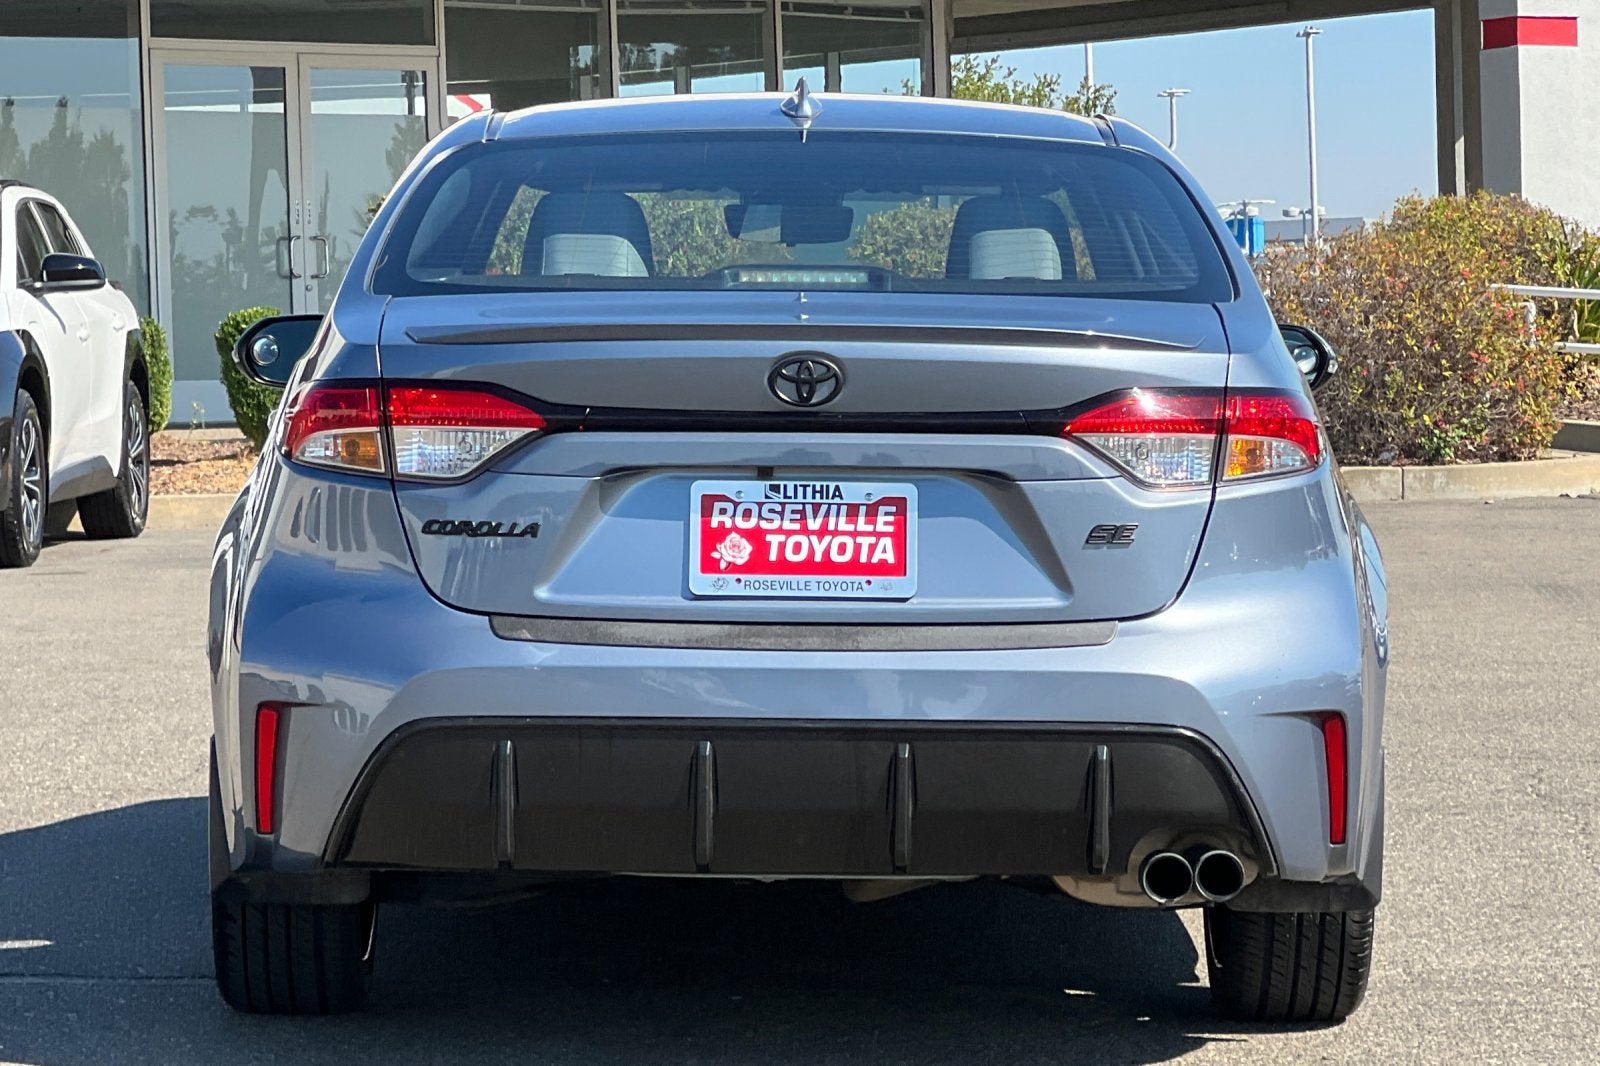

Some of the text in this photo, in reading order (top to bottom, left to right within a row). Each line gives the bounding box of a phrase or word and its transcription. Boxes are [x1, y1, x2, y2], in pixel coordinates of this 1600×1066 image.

[783, 483, 844, 500] LITHIA
[710, 501, 897, 533] ROSEVILLE
[421, 519, 541, 538] COROLLA
[1085, 524, 1139, 544] SE
[765, 534, 896, 564] TOYOTA
[743, 579, 864, 592] ROSEVILLE TOYOTA
